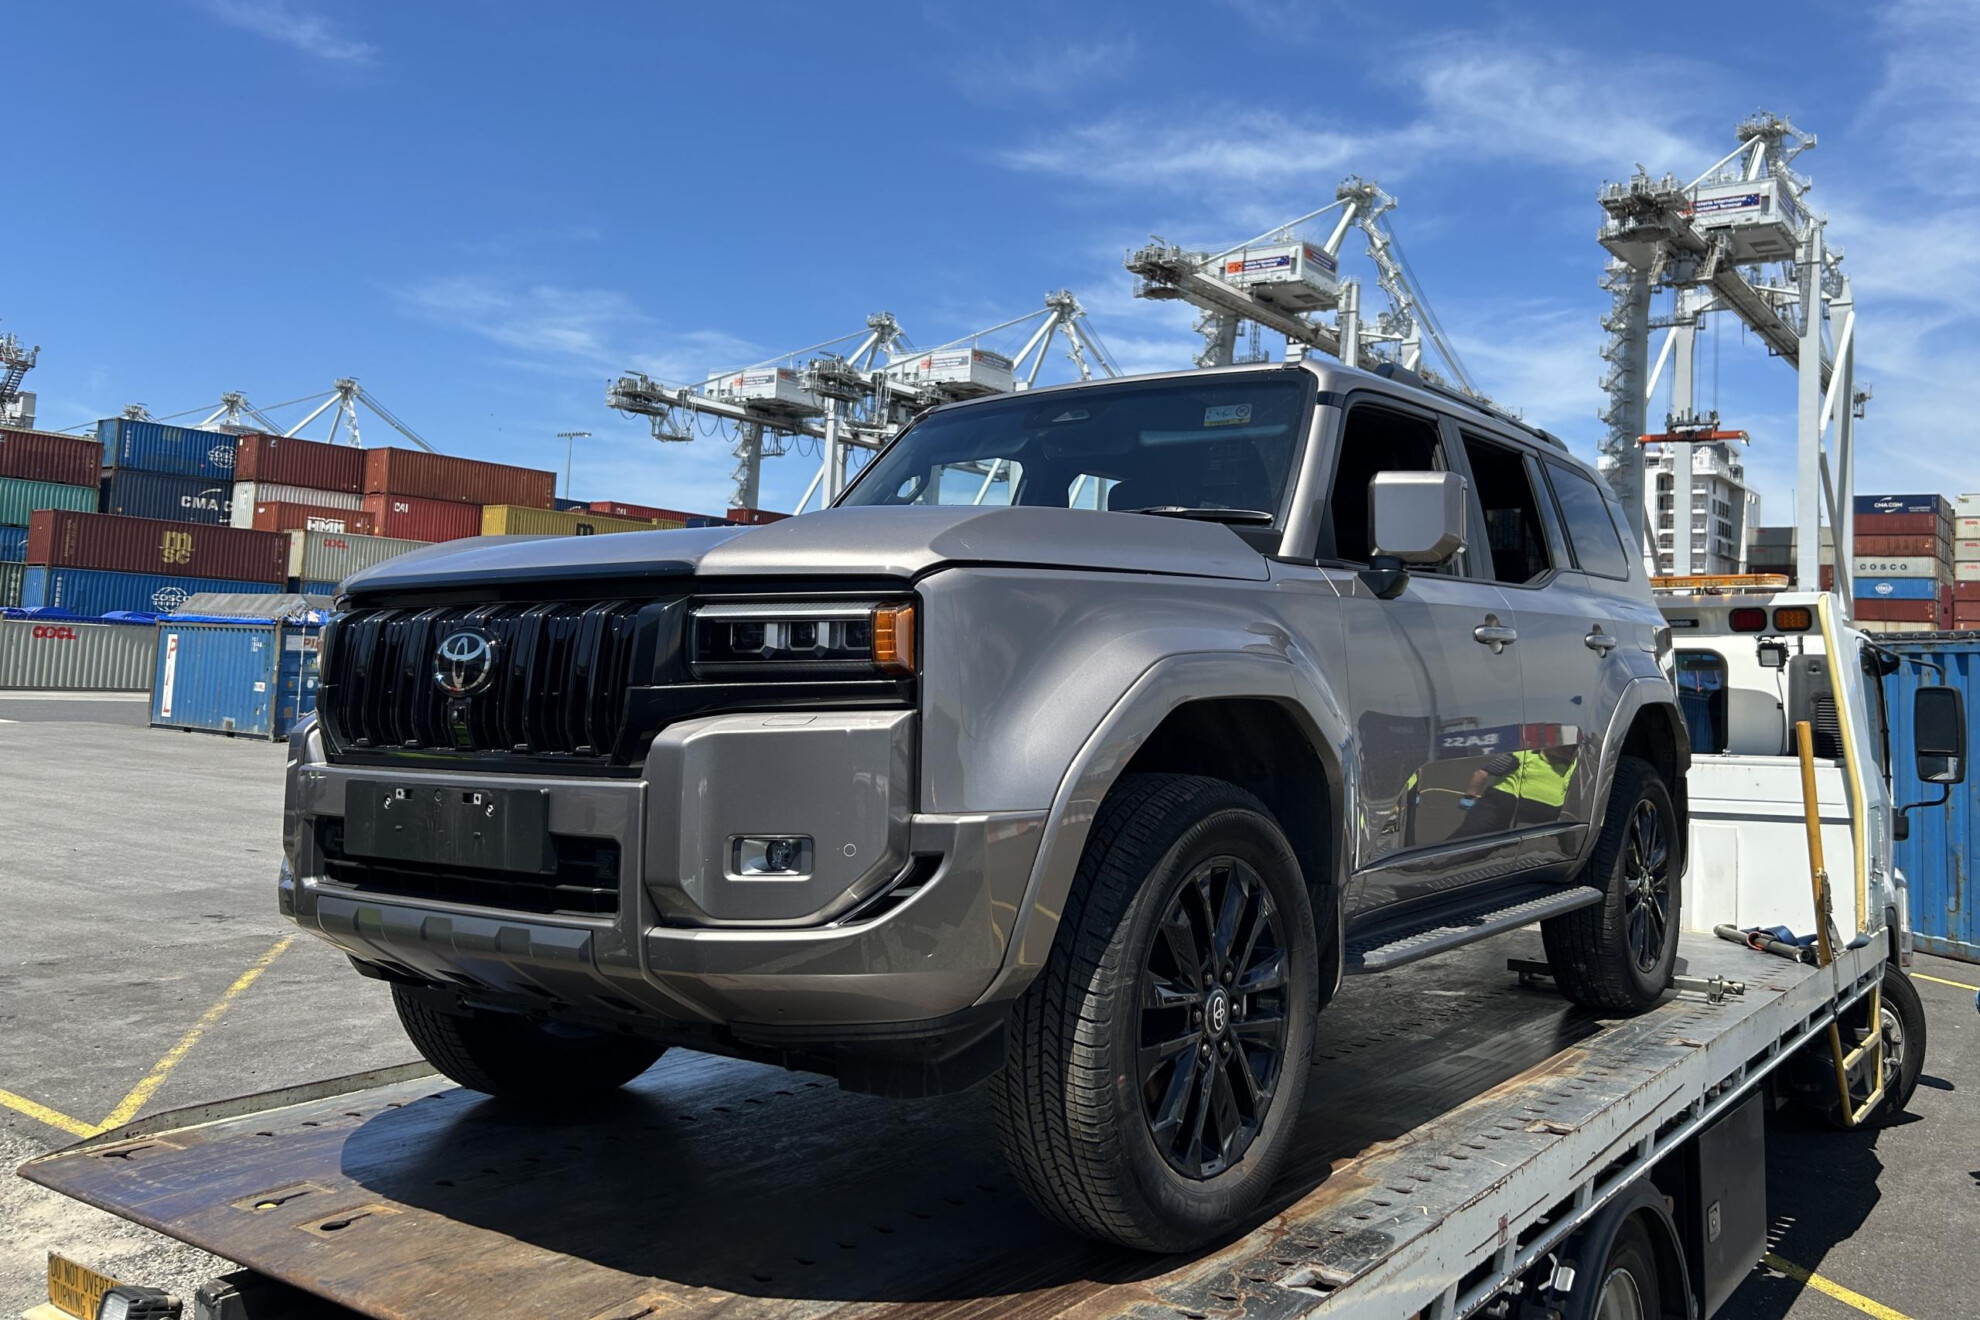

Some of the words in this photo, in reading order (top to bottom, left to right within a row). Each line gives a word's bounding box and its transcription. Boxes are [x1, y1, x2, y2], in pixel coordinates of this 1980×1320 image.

[181, 495, 218, 511] CMA
[33, 625, 77, 640] OOCL
[64, 1261, 79, 1289] NOT
[53, 1281, 86, 1317] TURNING
